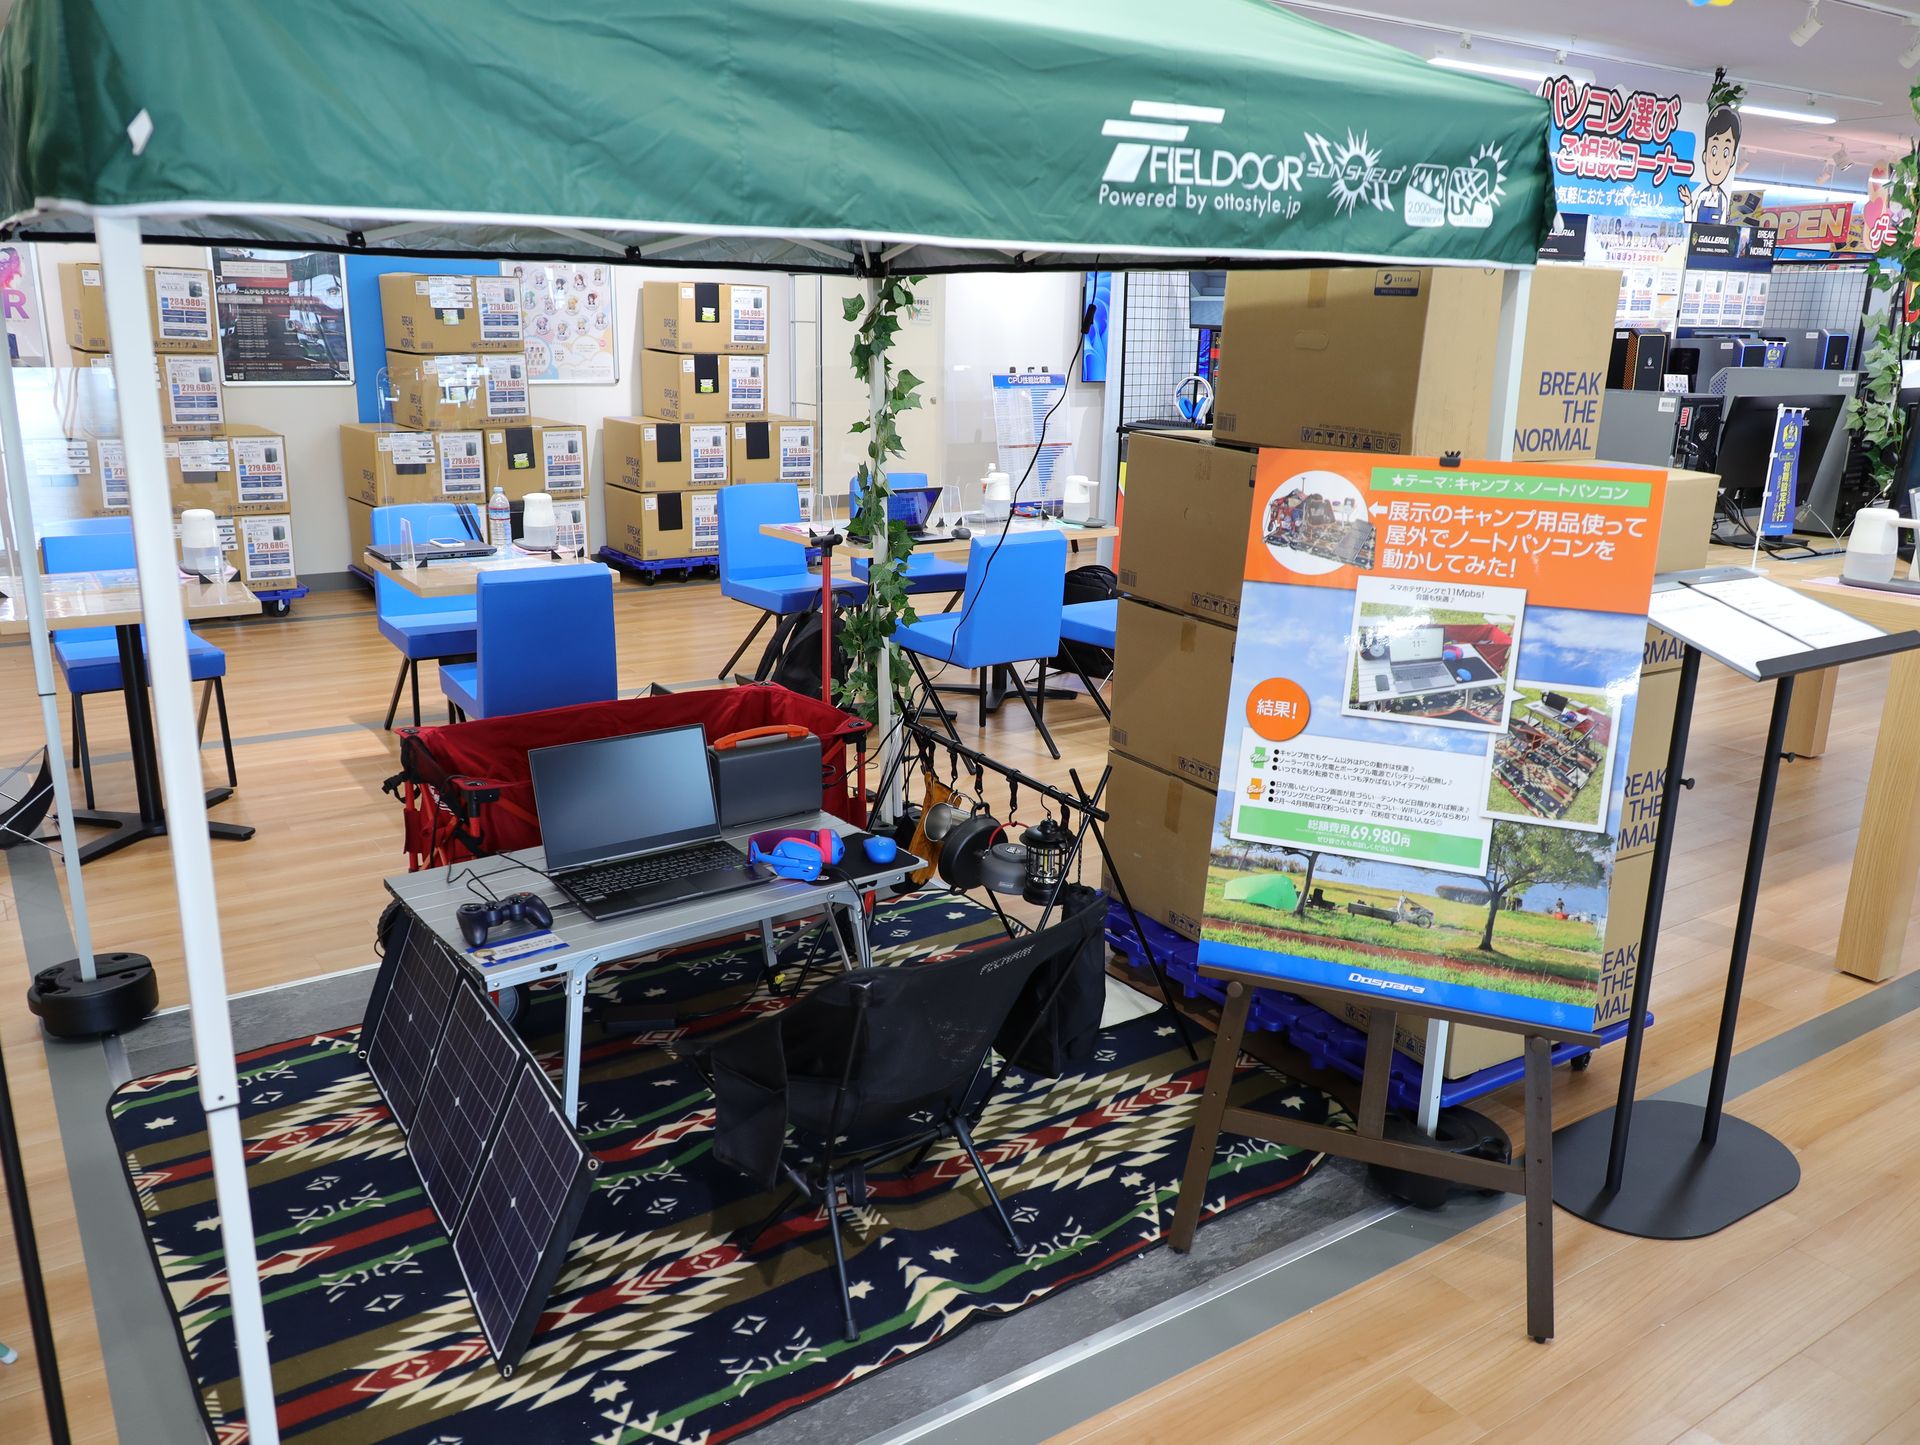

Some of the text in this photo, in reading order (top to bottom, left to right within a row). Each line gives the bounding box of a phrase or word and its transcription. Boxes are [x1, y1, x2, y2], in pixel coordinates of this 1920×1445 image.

[1543, 76, 1682, 144] パソコン選び
[1150, 145, 1303, 191] FIELDOOR
[1556, 132, 1694, 187] ご相談コーナー
[1098, 184, 1301, 219] Powered by ottostyle.jp
[1760, 207, 1846, 240] OPEN
[1698, 235, 1729, 245] GALLERIA
[1539, 371, 1602, 396] BREAK
[1562, 400, 1598, 423] THE
[1513, 427, 1592, 453] NORMAL
[1529, 482, 1630, 500] ノートパソコン
[1387, 501, 1648, 538] 展示のキャンプ用品使って
[1384, 525, 1616, 562] 屋外でノートパソコンを
[1381, 548, 1517, 579] 動かしてみた!
[1256, 698, 1298, 720] 結果!
[1629, 794, 1664, 822] THE
[1602, 942, 1639, 974] EAK
[1348, 972, 1426, 994] Dospara
[1601, 966, 1635, 997] THE
[1594, 992, 1630, 1024] MAL
